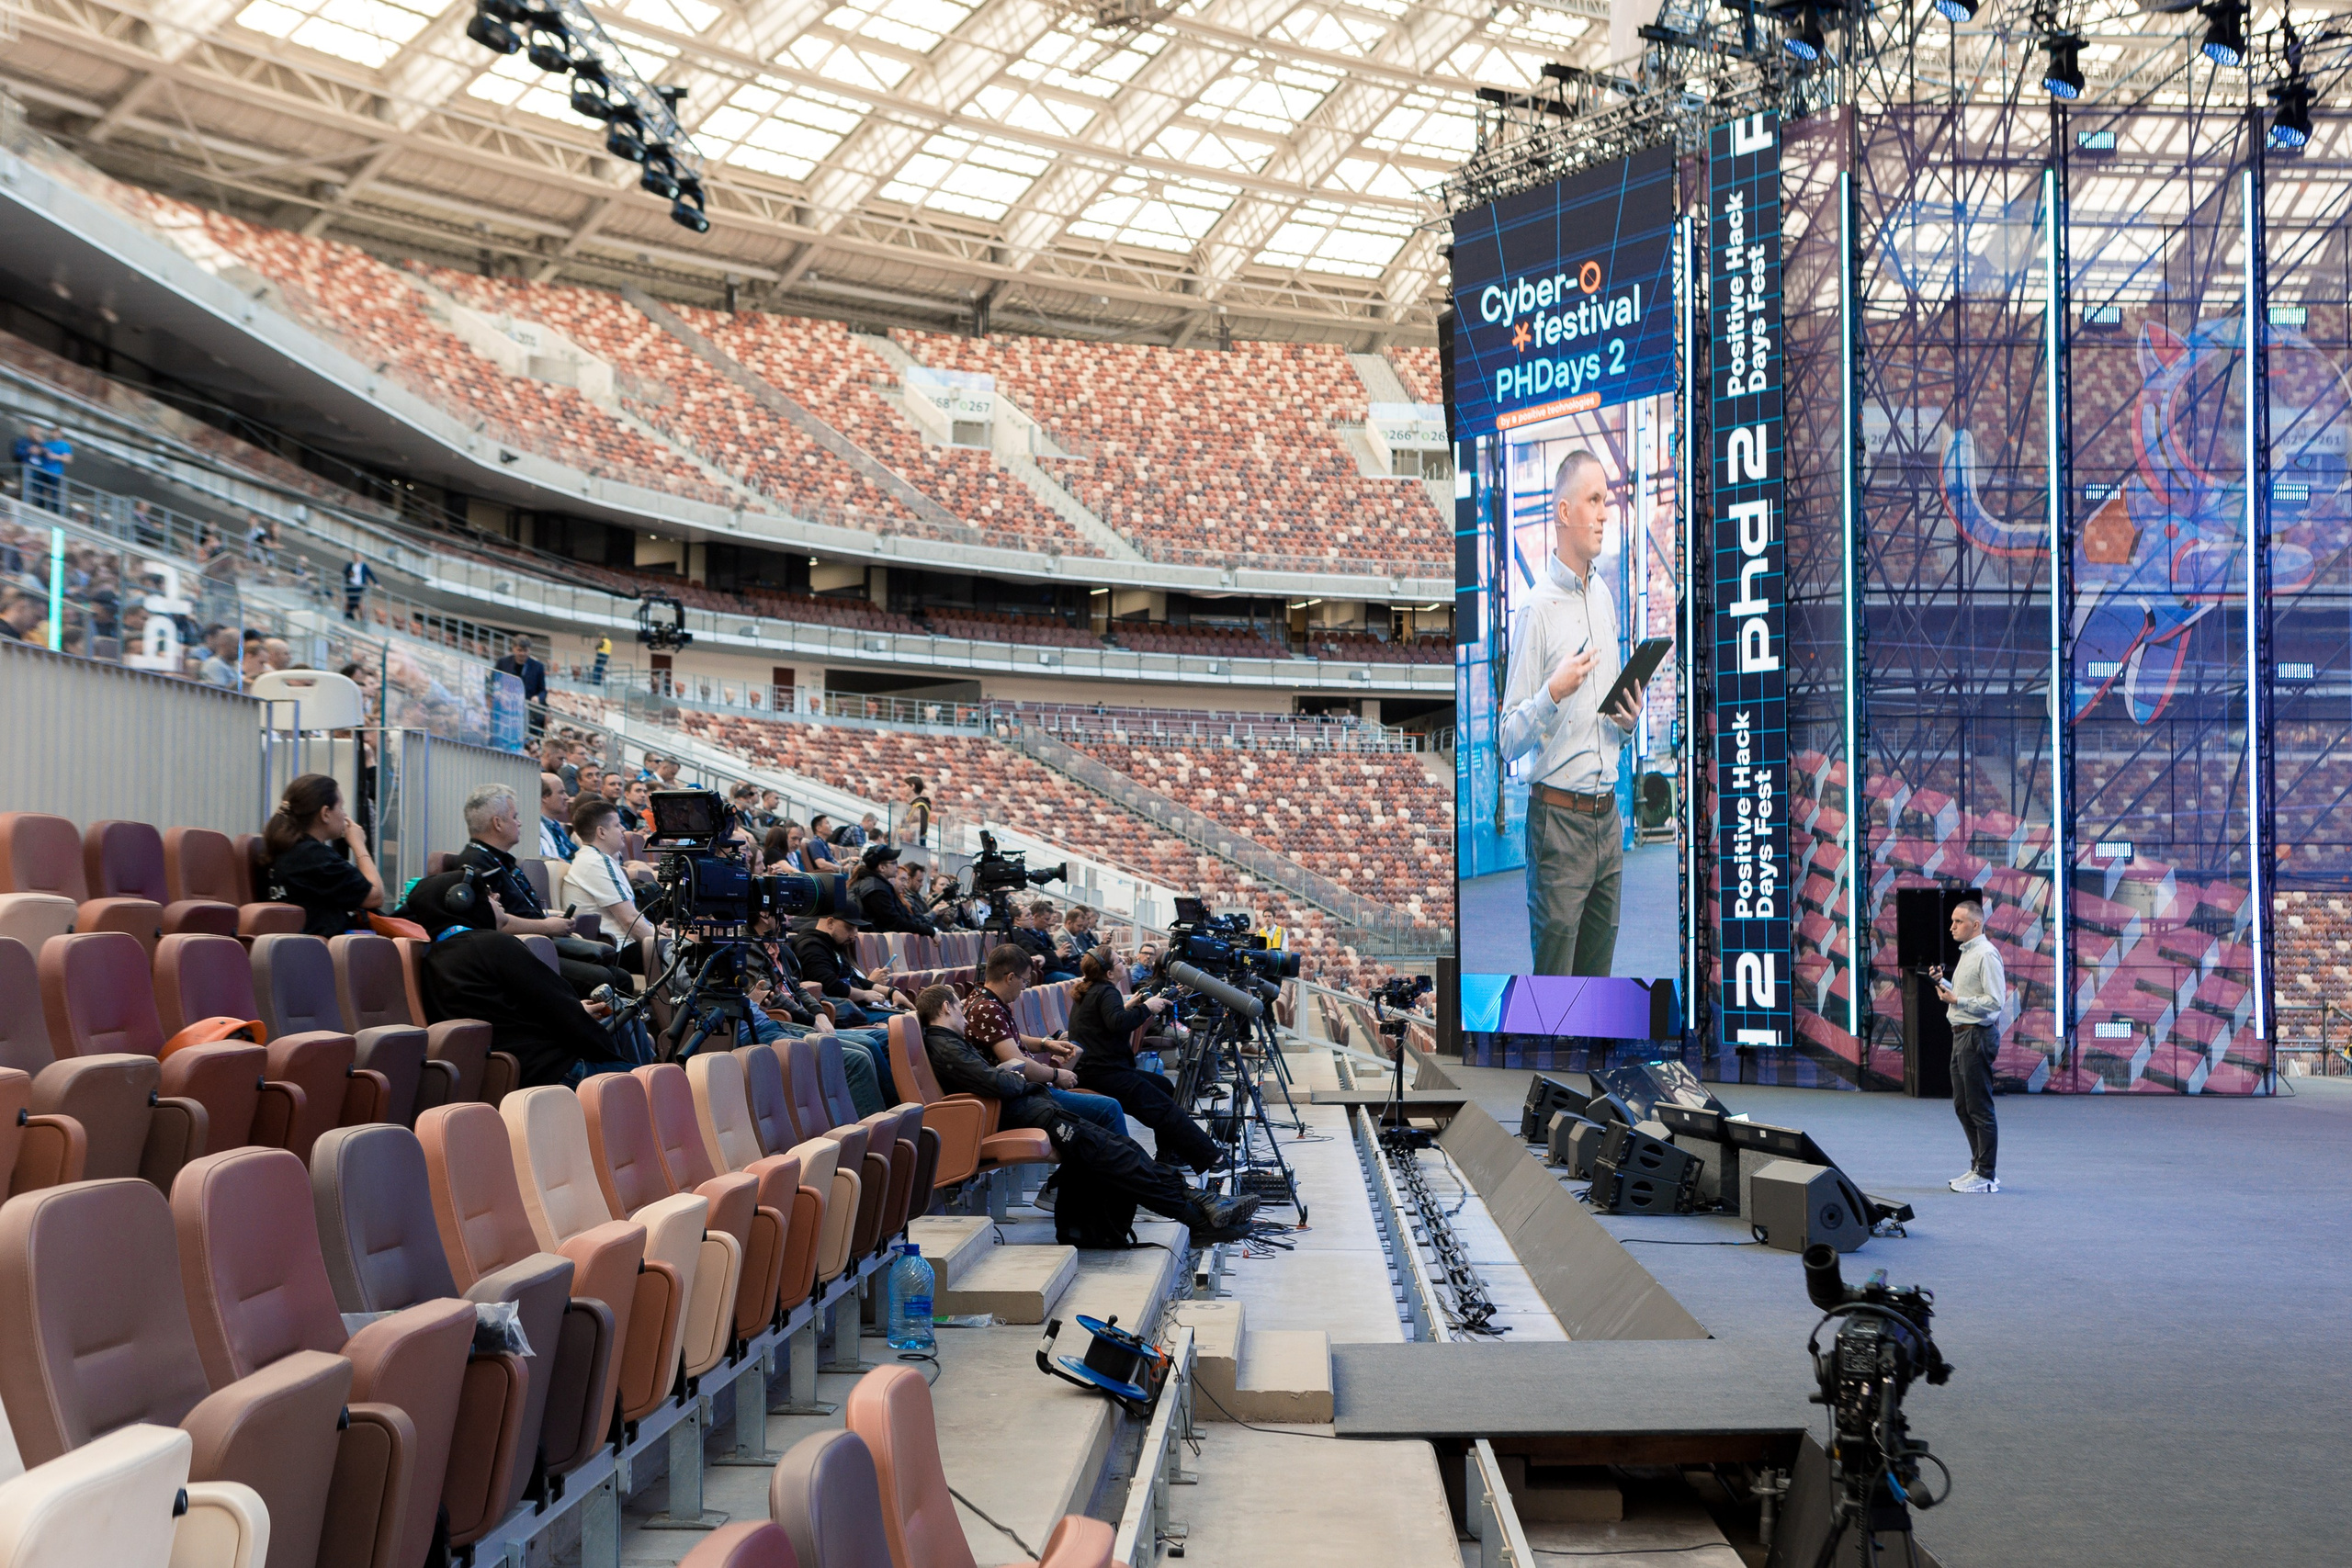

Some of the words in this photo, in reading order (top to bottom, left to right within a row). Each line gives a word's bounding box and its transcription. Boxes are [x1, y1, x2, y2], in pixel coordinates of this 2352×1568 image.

[1724, 190, 1745, 270] Hack
[1480, 274, 1578, 327] Cyber-
[1747, 243, 1766, 312] Fest
[1532, 283, 1641, 348] festival
[1726, 276, 1746, 397] Positive
[1496, 353, 1601, 403] PHDays
[1609, 337, 1626, 376] 2
[1748, 317, 1770, 393] Days
[968, 400, 990, 412] 267
[1389, 429, 1412, 441] 266
[1430, 430, 1449, 442] 26
[1500, 416, 1511, 428] by
[1518, 408, 1547, 424] positive
[1547, 395, 1595, 416] technologies
[1727, 423, 1768, 484] 2
[1729, 499, 1780, 673] phd
[1732, 710, 1751, 789] Hack
[1754, 770, 1773, 835] Fest
[1733, 797, 1753, 919] Positive
[1756, 844, 1779, 918] Days
[1736, 952, 1776, 1008] 2
